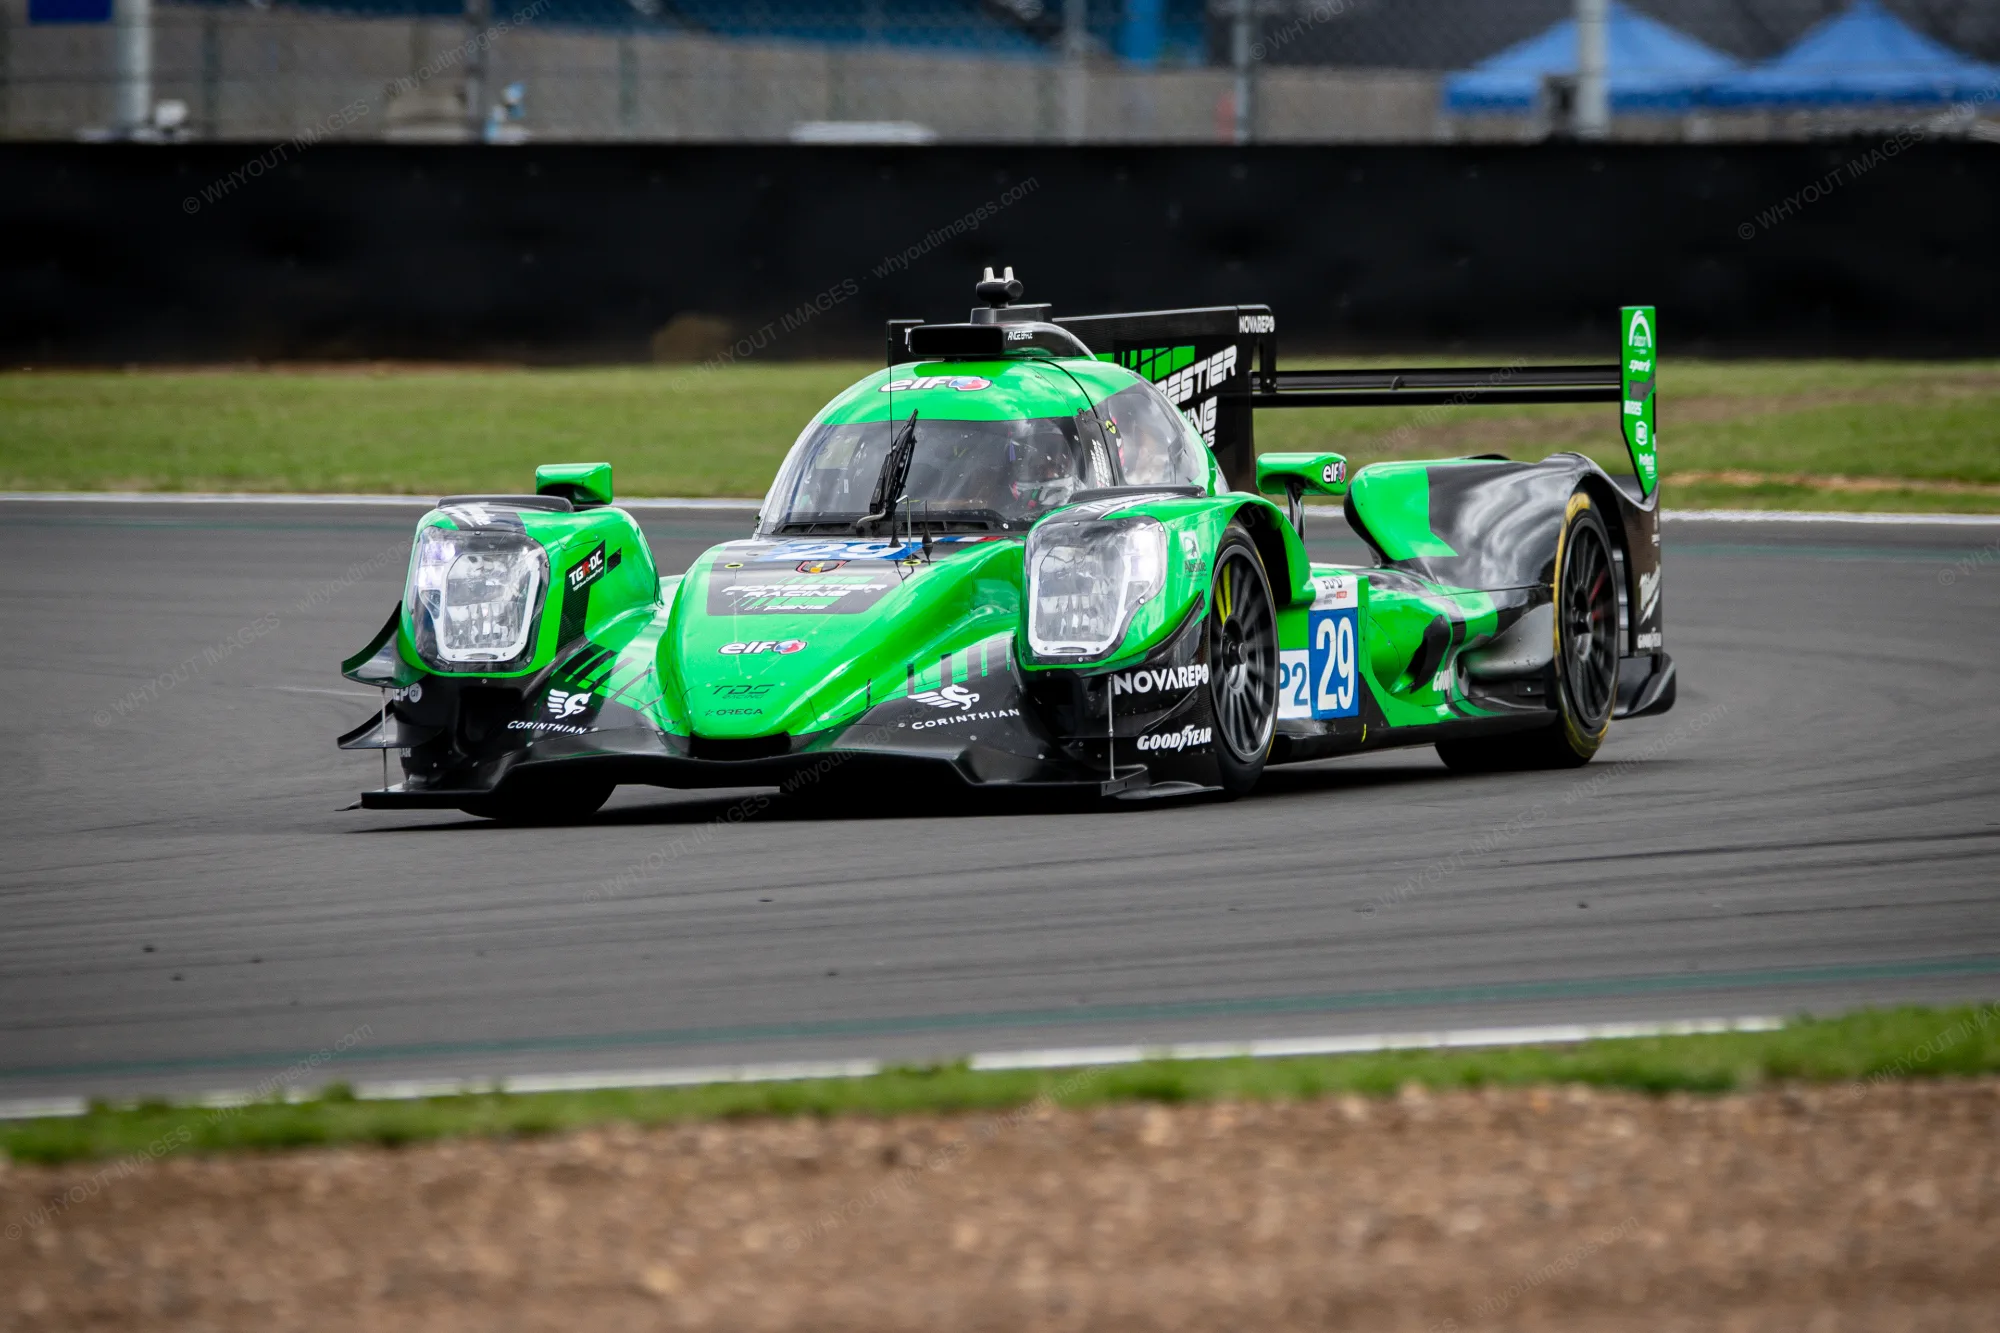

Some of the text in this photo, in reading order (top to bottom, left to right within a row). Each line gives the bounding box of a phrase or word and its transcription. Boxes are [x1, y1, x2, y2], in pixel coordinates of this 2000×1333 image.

[774, 542, 907, 560] 29
[722, 584, 888, 593] FORESTIER
[1316, 616, 1355, 711] 29
[712, 684, 776, 695] TDS
[716, 708, 764, 716] ORECA
[911, 708, 1021, 730] CORINTHIAN
[507, 720, 587, 735] CORINTHIAN
[1136, 724, 1212, 752] GOODYEAR
